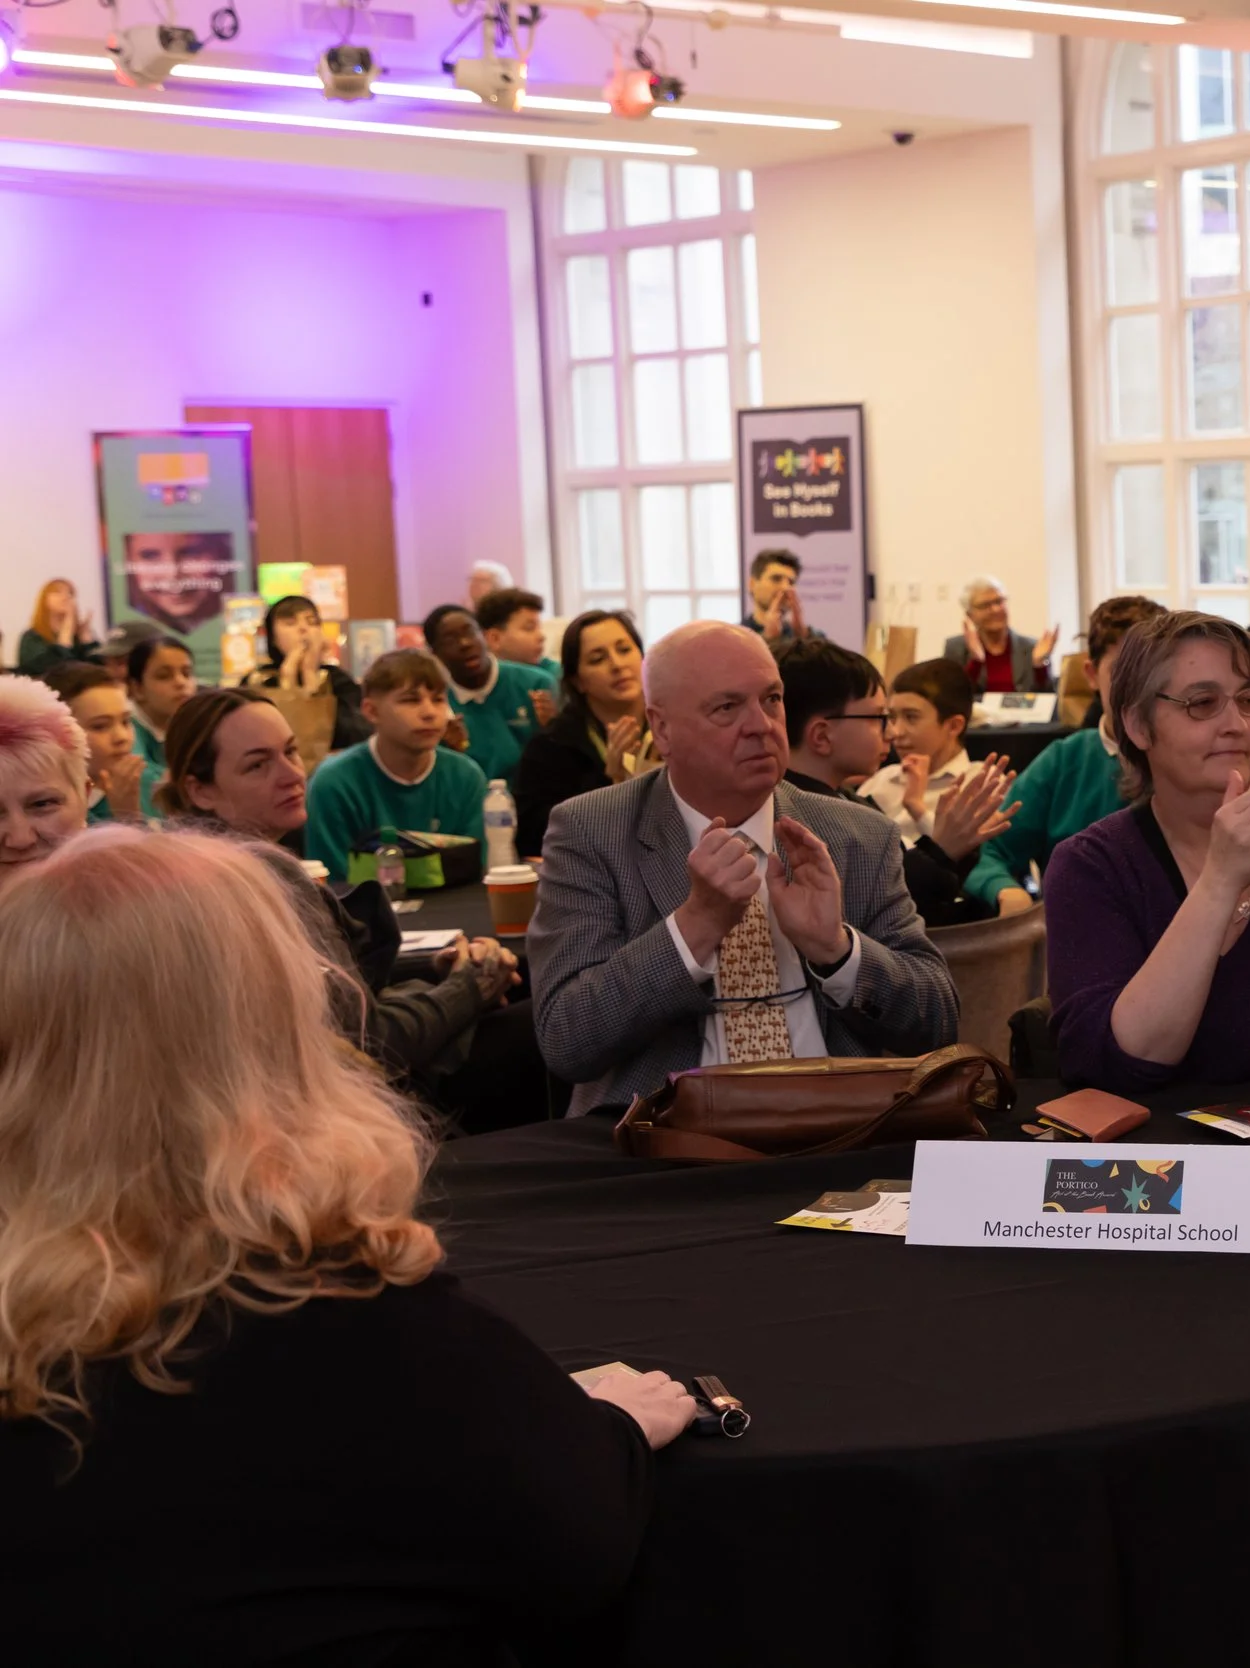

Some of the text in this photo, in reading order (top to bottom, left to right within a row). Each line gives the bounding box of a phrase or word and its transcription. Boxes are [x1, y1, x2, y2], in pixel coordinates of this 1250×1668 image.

[763, 480, 841, 501] See Myself
[789, 501, 834, 518] Books
[1056, 1171, 1077, 1180] THE
[1055, 1181, 1099, 1190] PORTICO
[983, 1220, 1239, 1244] Manchester Hospital School
